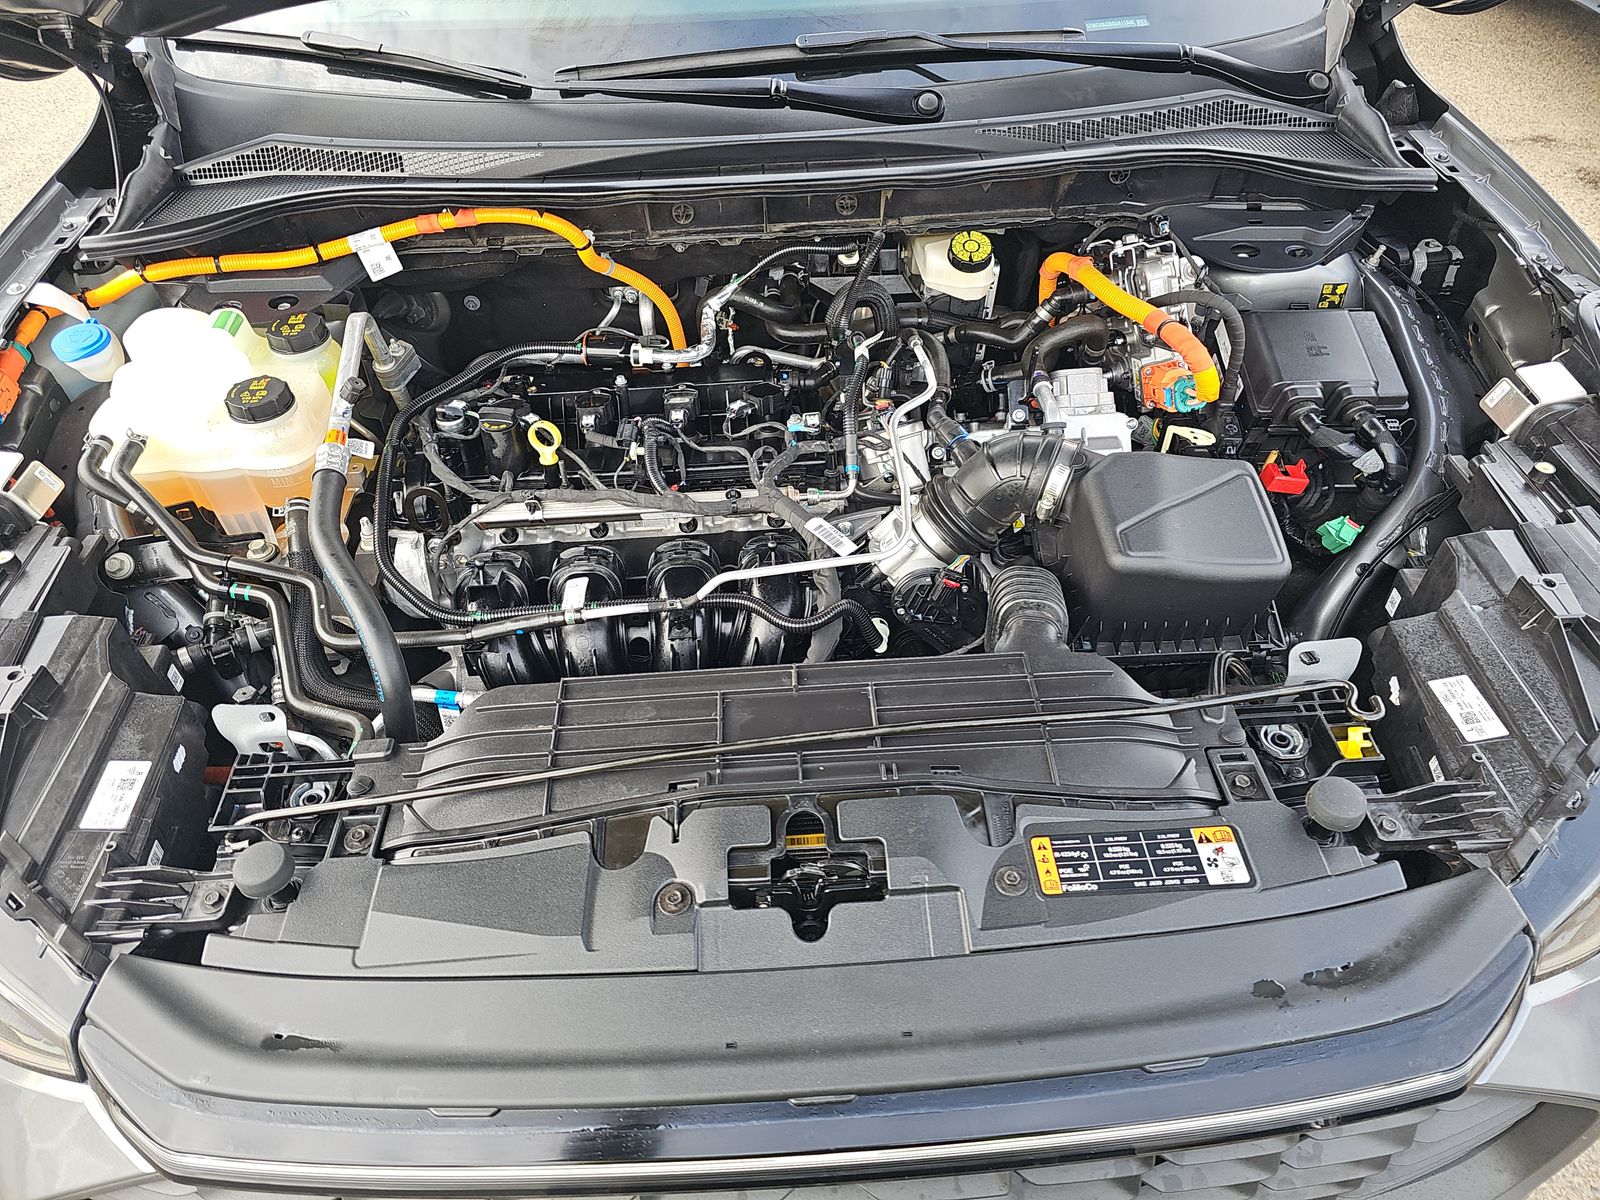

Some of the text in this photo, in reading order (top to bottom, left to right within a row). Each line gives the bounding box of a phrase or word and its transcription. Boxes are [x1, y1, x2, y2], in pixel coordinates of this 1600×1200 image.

[270, 476, 295, 486] MIN
[373, 671, 385, 702] GALAXY
[1062, 884, 1099, 892] FoMoCo
